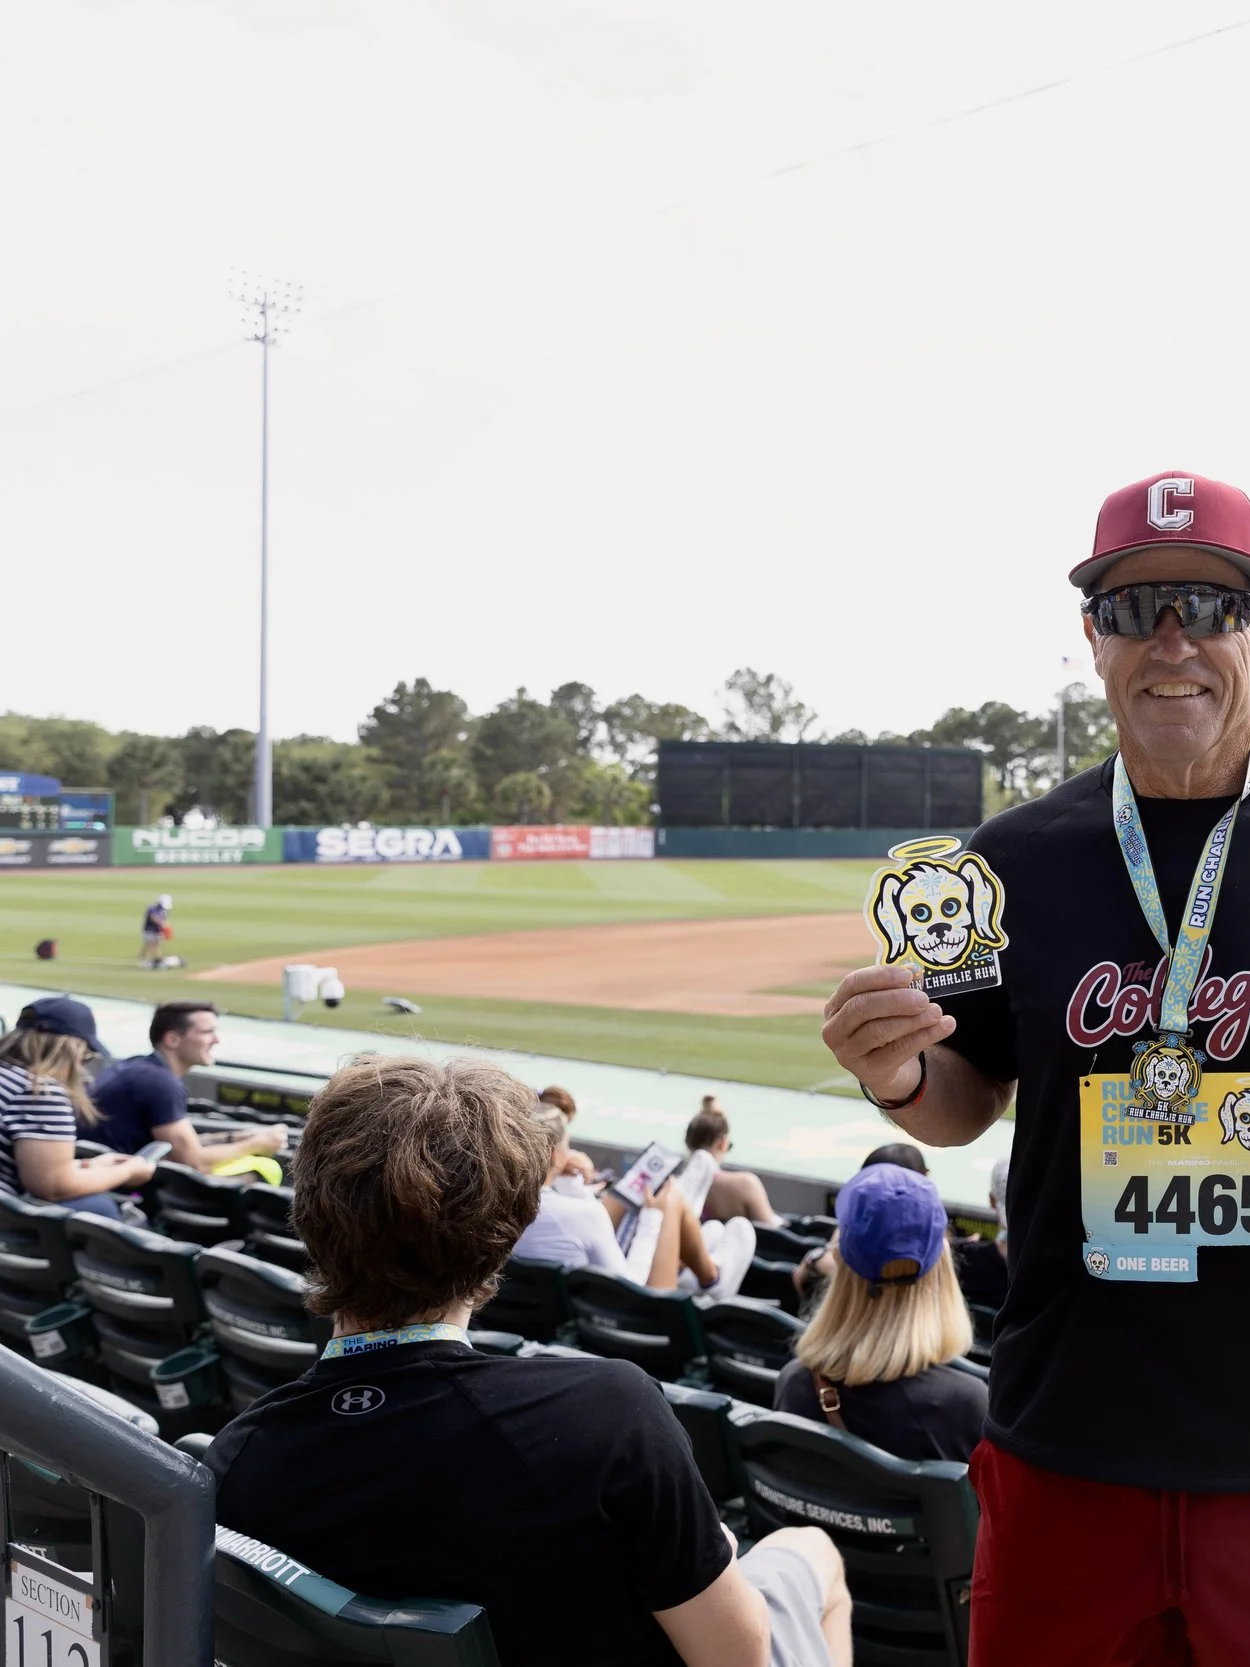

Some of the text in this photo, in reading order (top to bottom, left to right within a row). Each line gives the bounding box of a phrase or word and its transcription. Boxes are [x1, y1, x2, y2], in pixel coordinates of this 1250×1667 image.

[1147, 478, 1194, 531] C
[132, 827, 266, 848] NUCOR
[1189, 885, 1213, 928] RUN
[925, 969, 973, 990] CHARLIE
[974, 965, 997, 980] RUN
[1102, 1080, 1140, 1100] RU
[1129, 1107, 1193, 1124] RUN CHARLIE RUN
[1102, 1124, 1192, 1146] RUN 5K
[1116, 1257, 1189, 1272] ONE BEER
[343, 1339, 398, 1356] MARINO
[344, 1337, 363, 1346] THE
[806, 1502, 867, 1532] SERVICES,
[868, 1518, 896, 1533] INC.
[21, 1575, 80, 1622] SECTION
